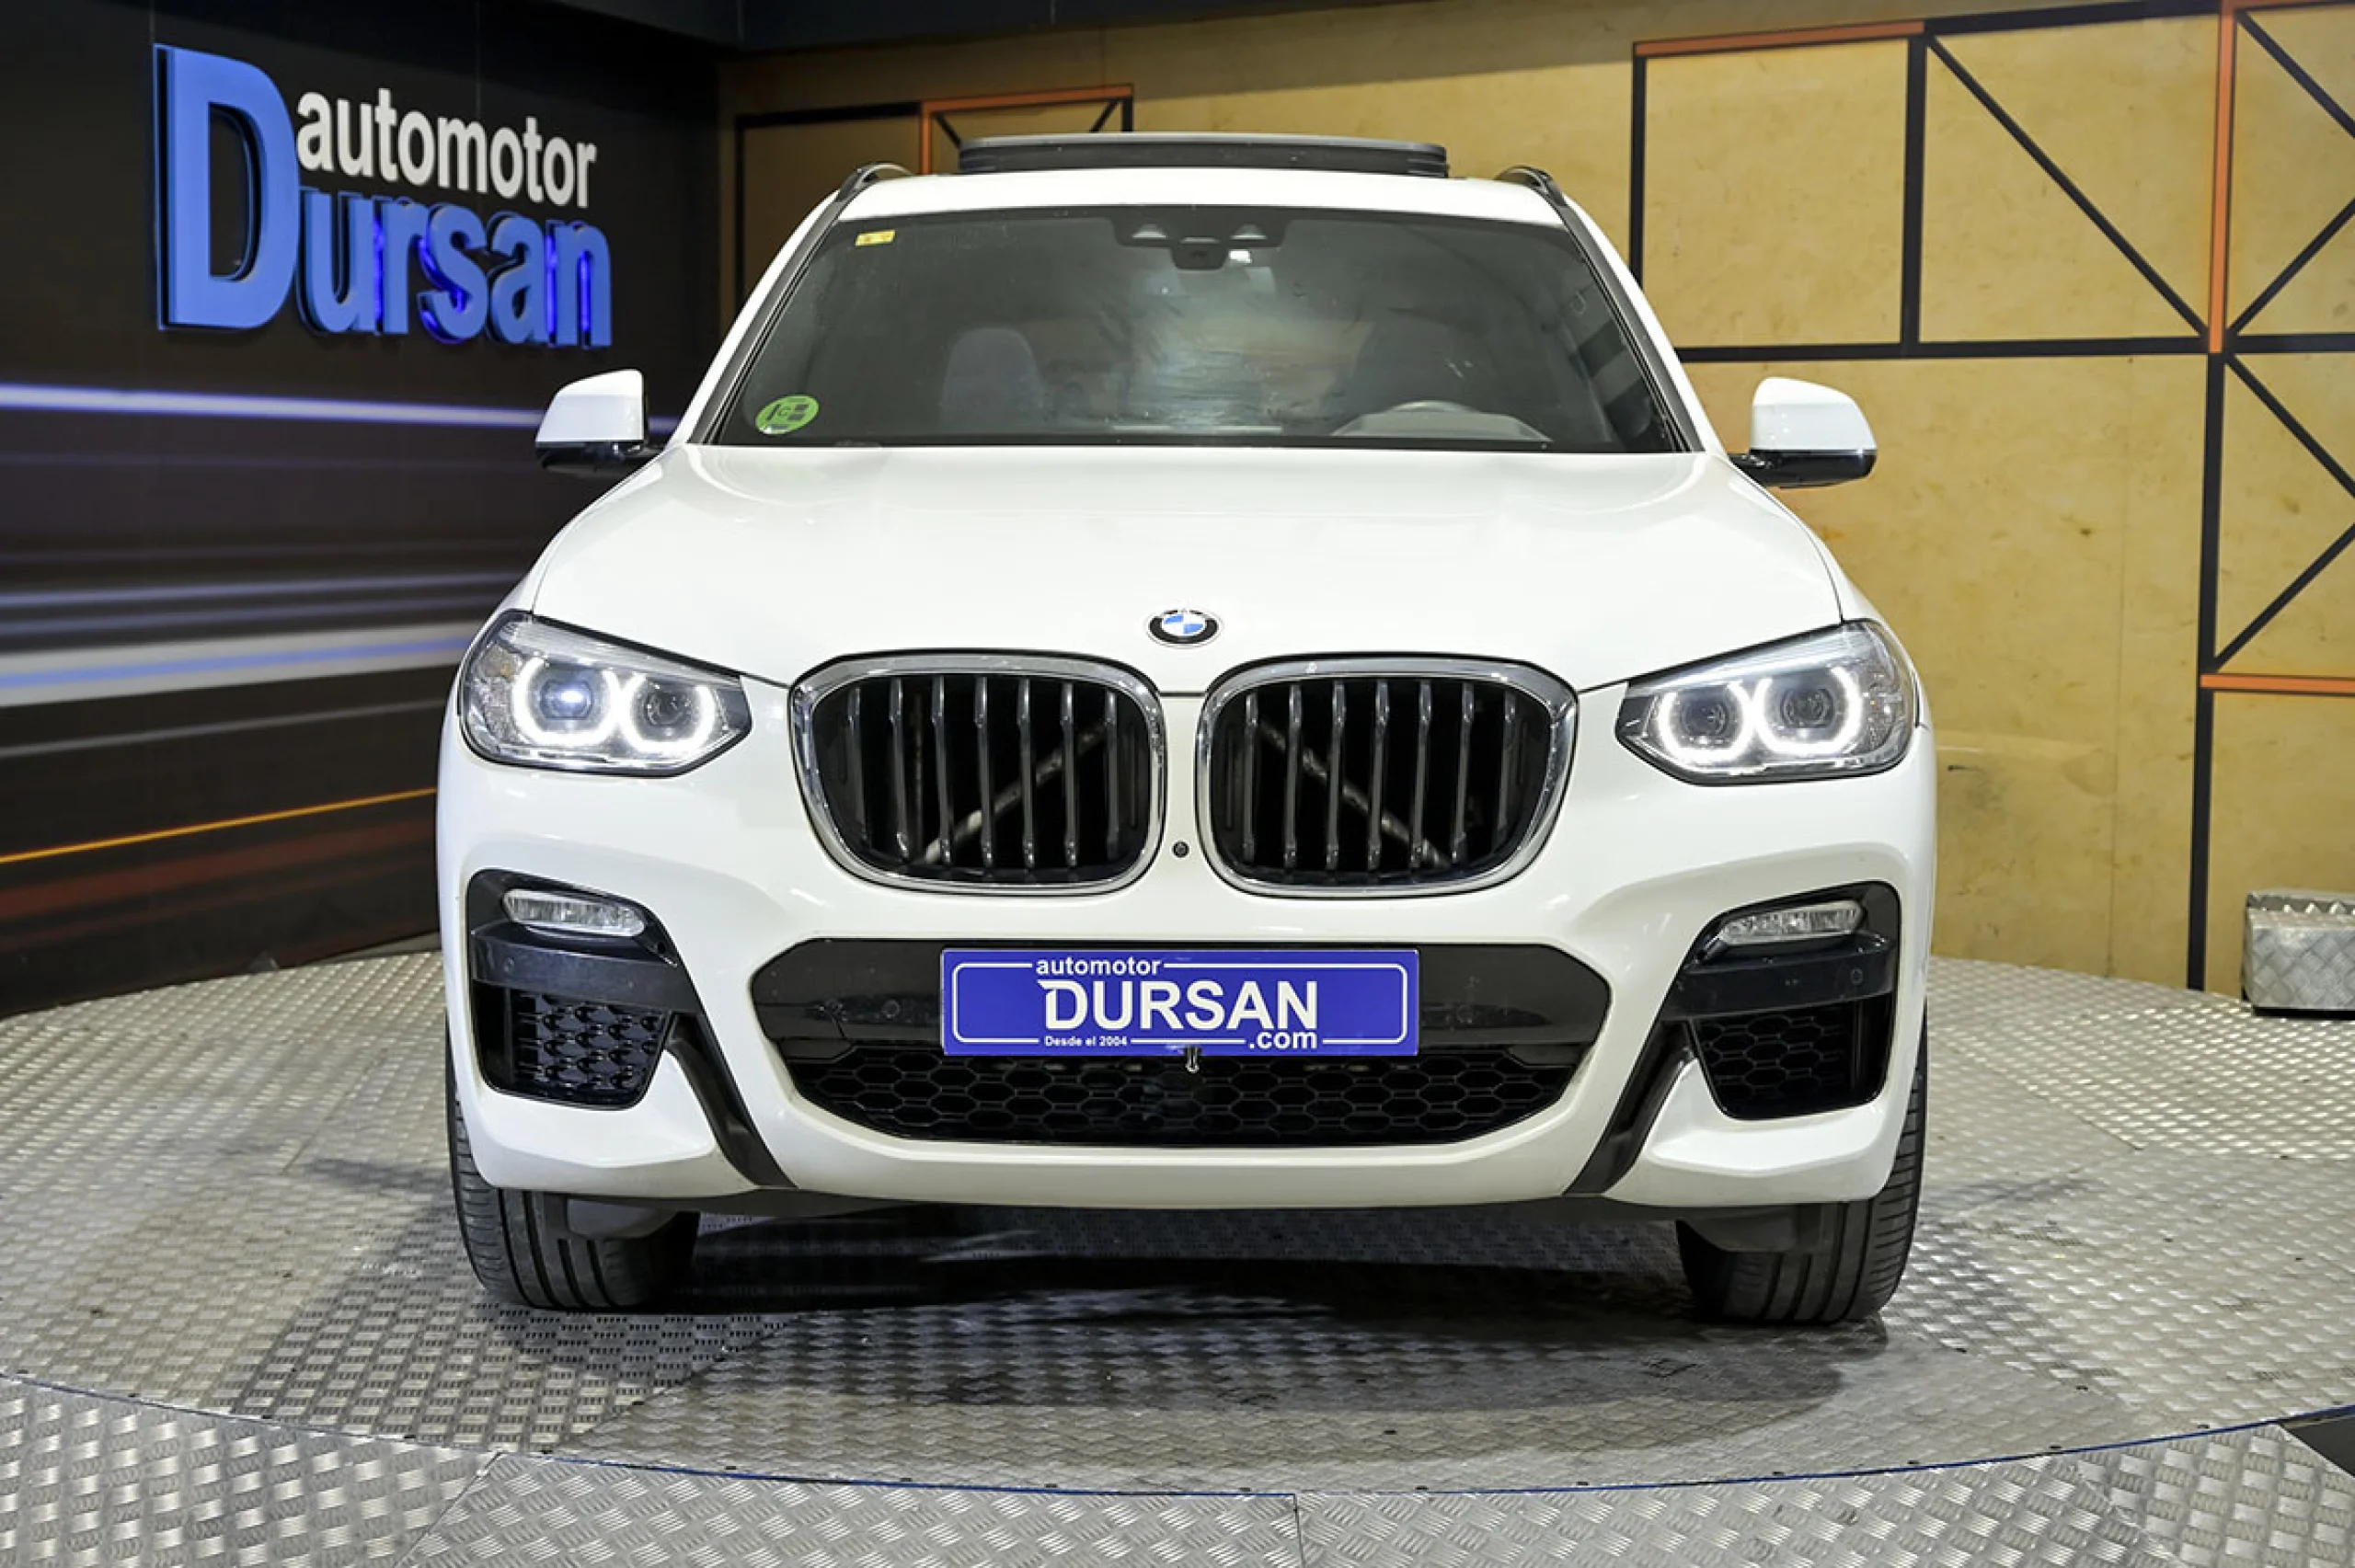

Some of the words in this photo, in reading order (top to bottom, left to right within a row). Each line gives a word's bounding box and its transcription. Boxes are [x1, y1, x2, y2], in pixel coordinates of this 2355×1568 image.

[296, 88, 597, 208] automotor
[154, 43, 612, 347] Dursan
[1036, 956, 1162, 976] automotor
[1037, 979, 1317, 1030] DURSAN
[1045, 1036, 1082, 1047] Desde
[1086, 1036, 1096, 1047] el
[1099, 1036, 1127, 1047] 2004
[1249, 1031, 1317, 1049] .com
